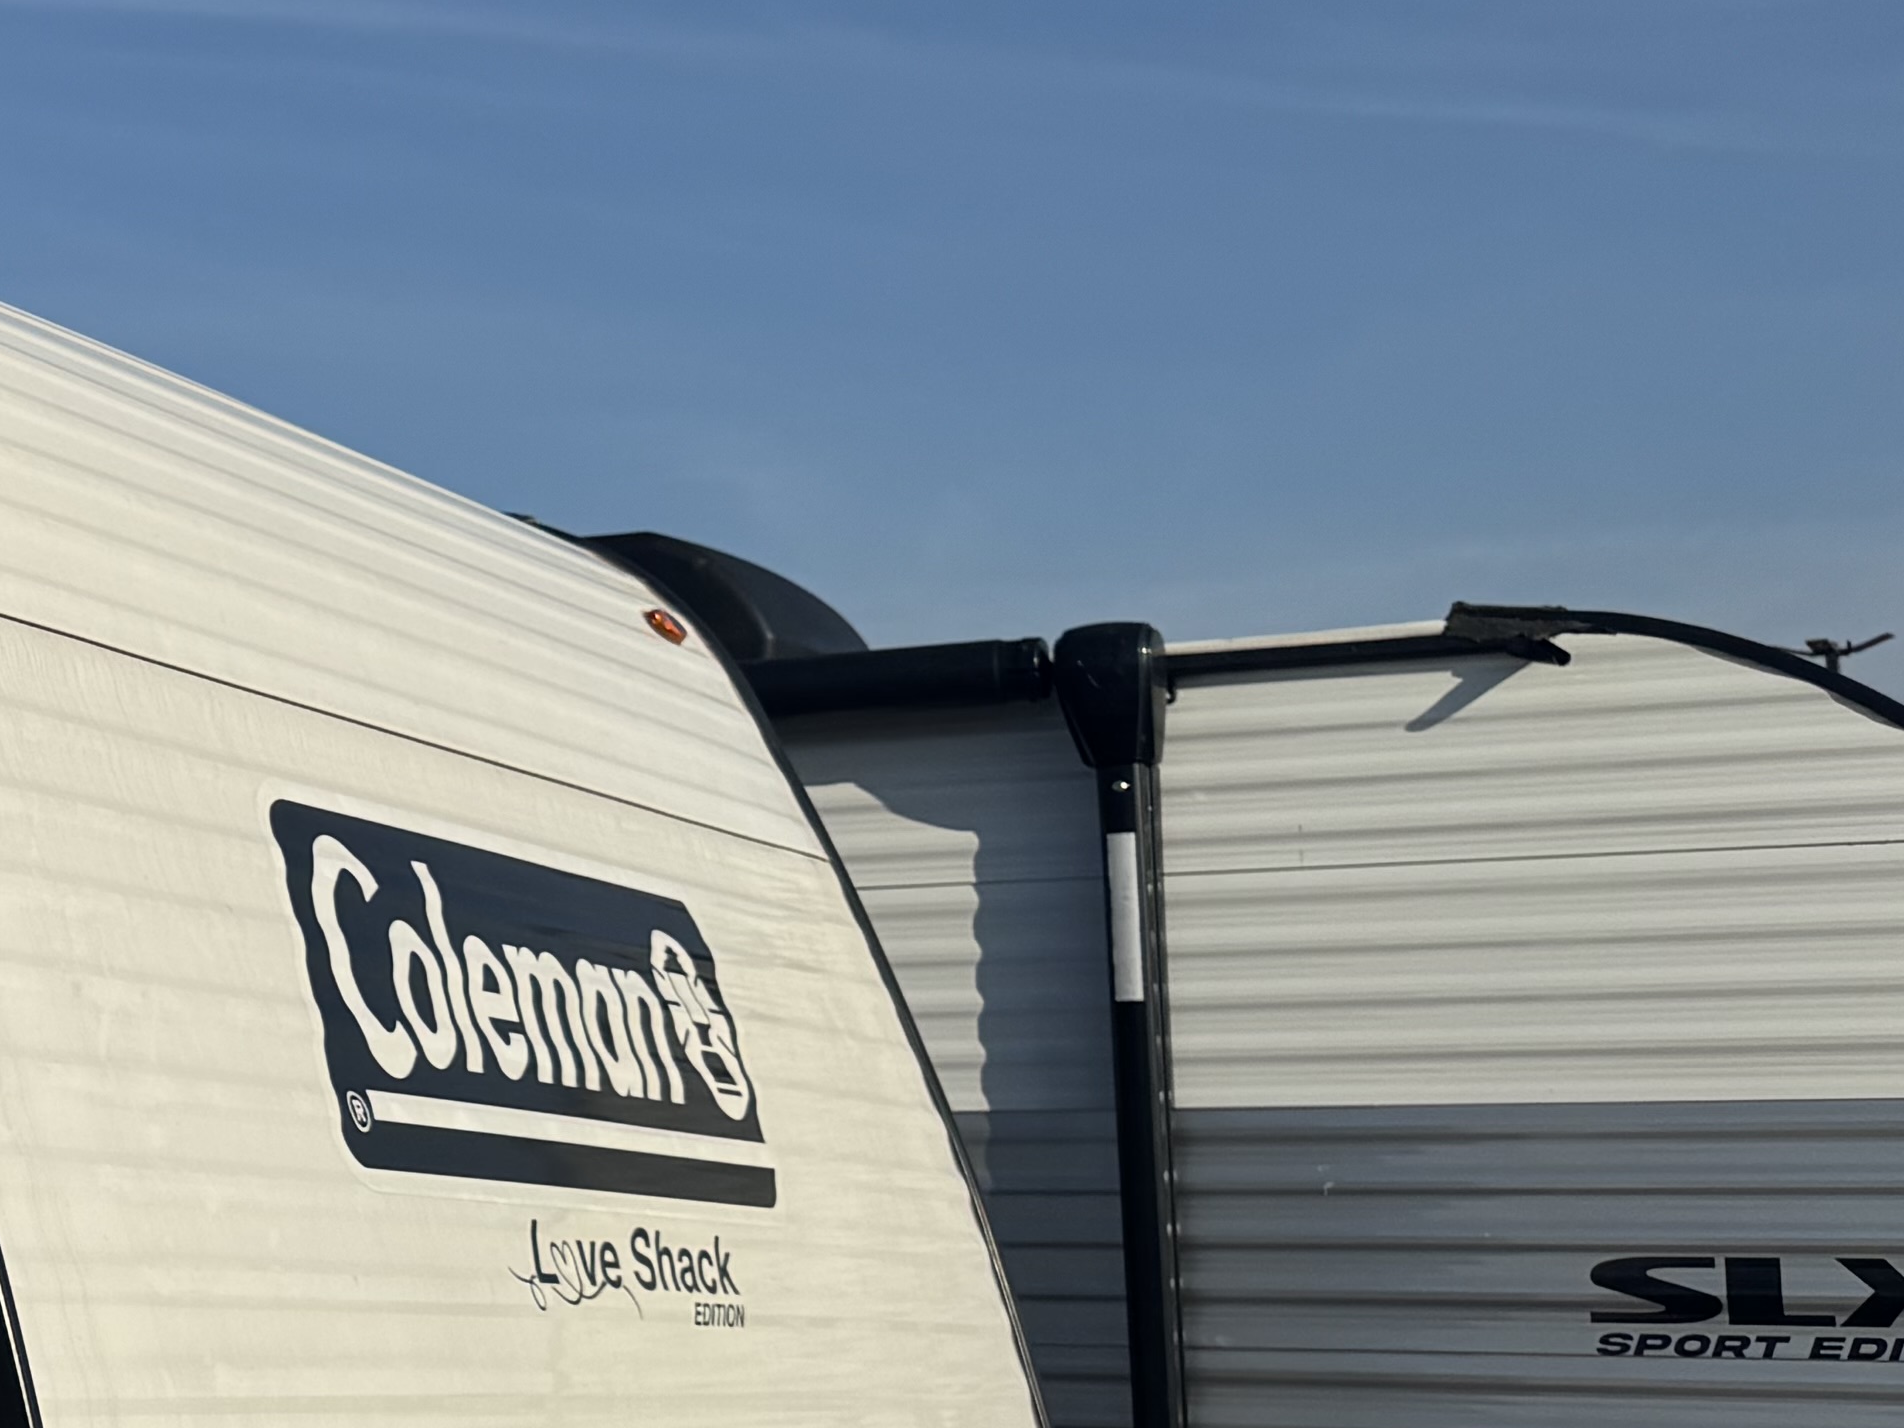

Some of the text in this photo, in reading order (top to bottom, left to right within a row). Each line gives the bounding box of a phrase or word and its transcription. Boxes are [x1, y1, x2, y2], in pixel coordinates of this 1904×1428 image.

[312, 834, 686, 1106] Coleman
[522, 1219, 740, 1300] Love Shack
[693, 1302, 745, 1328] EDITION
[1596, 1332, 1791, 1360] SPORT
